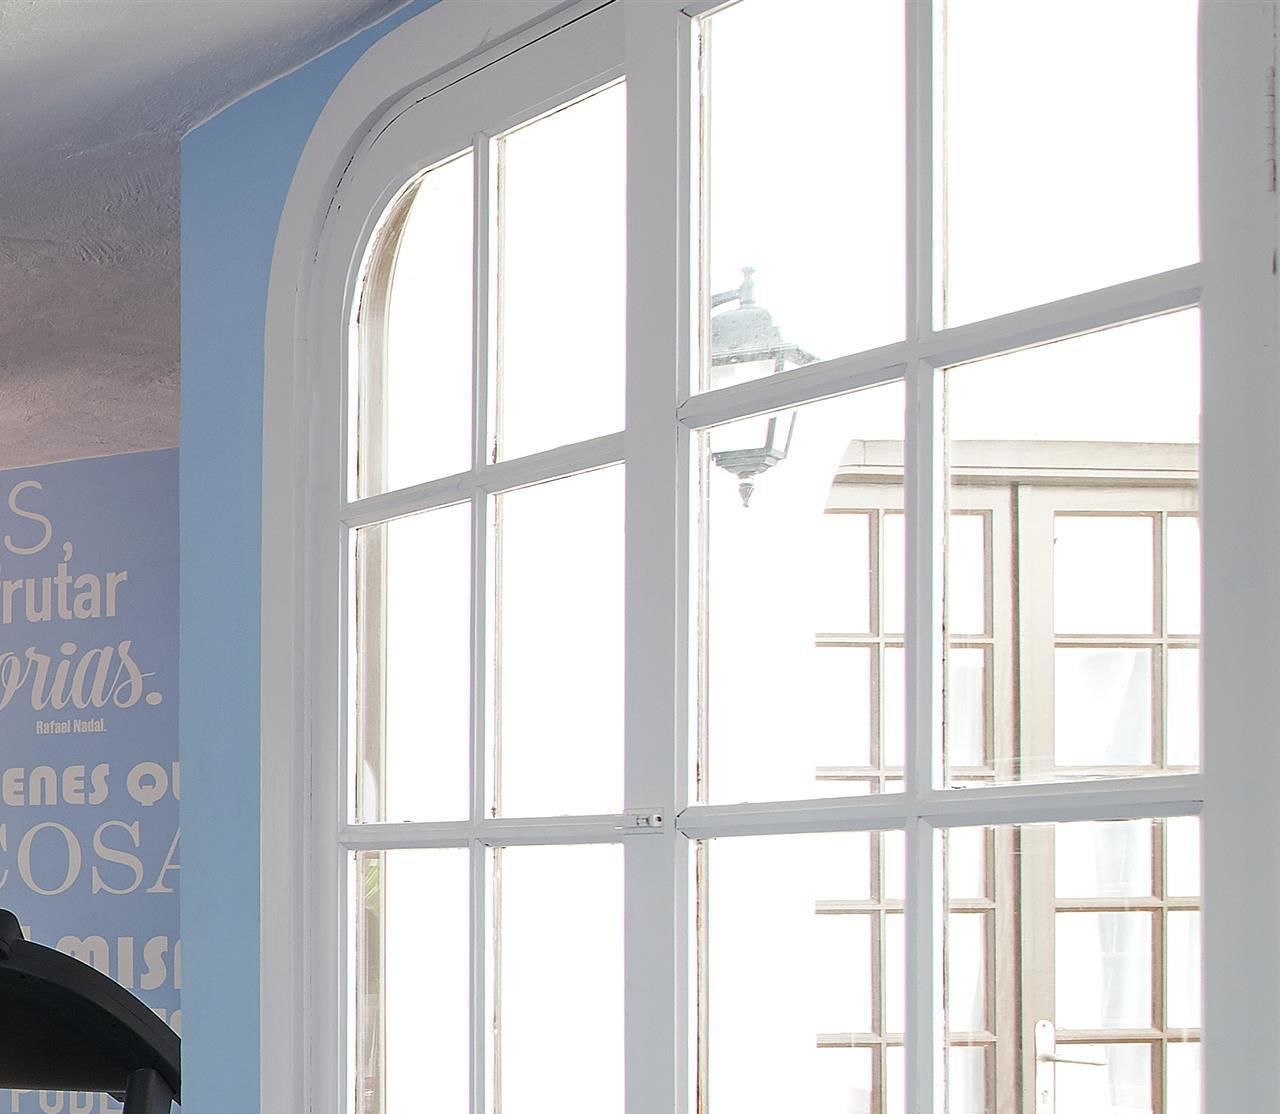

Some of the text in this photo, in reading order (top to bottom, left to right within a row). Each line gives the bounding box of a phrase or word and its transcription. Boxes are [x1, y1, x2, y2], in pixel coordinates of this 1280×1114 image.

[36, 718, 108, 735] Rafael Nadal.
[127, 761, 181, 806] Q
[56, 935, 181, 990] MIS
